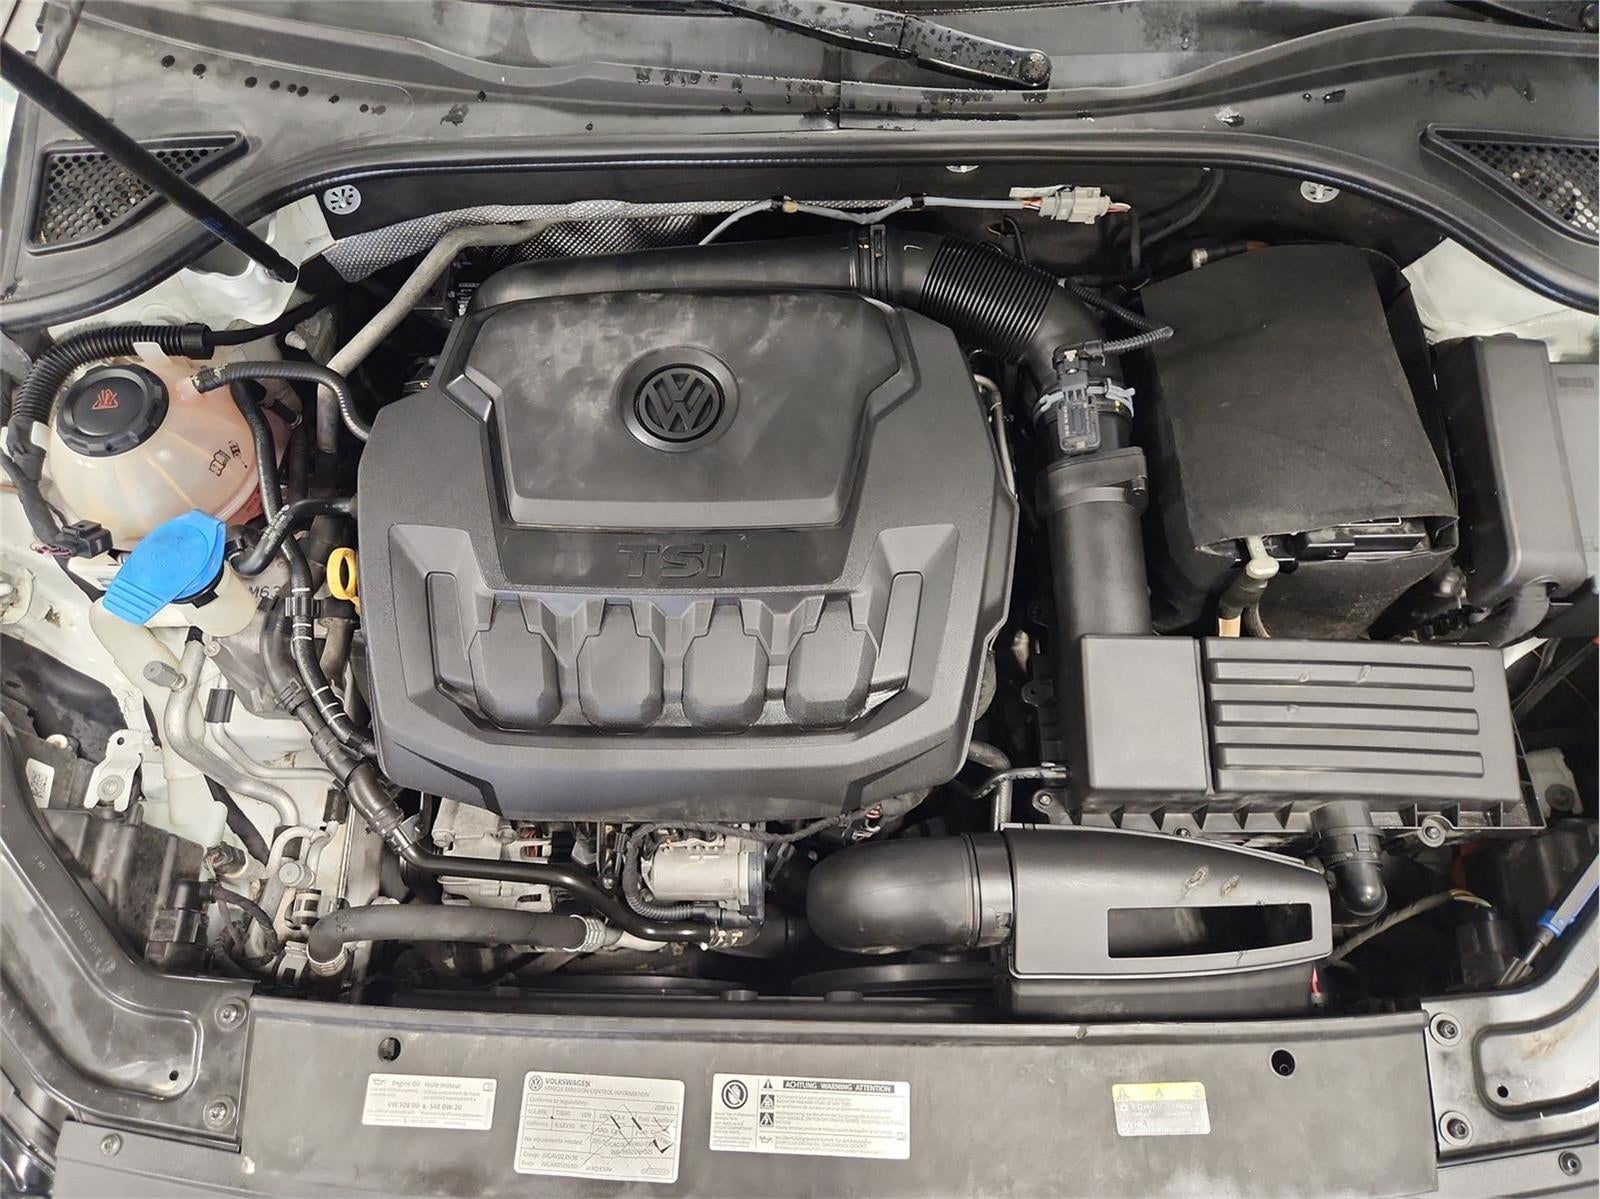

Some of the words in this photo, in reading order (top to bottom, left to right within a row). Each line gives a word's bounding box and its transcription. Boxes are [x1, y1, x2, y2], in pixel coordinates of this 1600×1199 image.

[618, 543, 727, 578] TSI
[391, 1079, 411, 1087] Engine
[545, 1077, 591, 1088] VOLKSWAGEN
[785, 1081, 818, 1090] ACHTUNG
[820, 1082, 853, 1091] WARNING
[854, 1084, 891, 1093] ATTENTION
